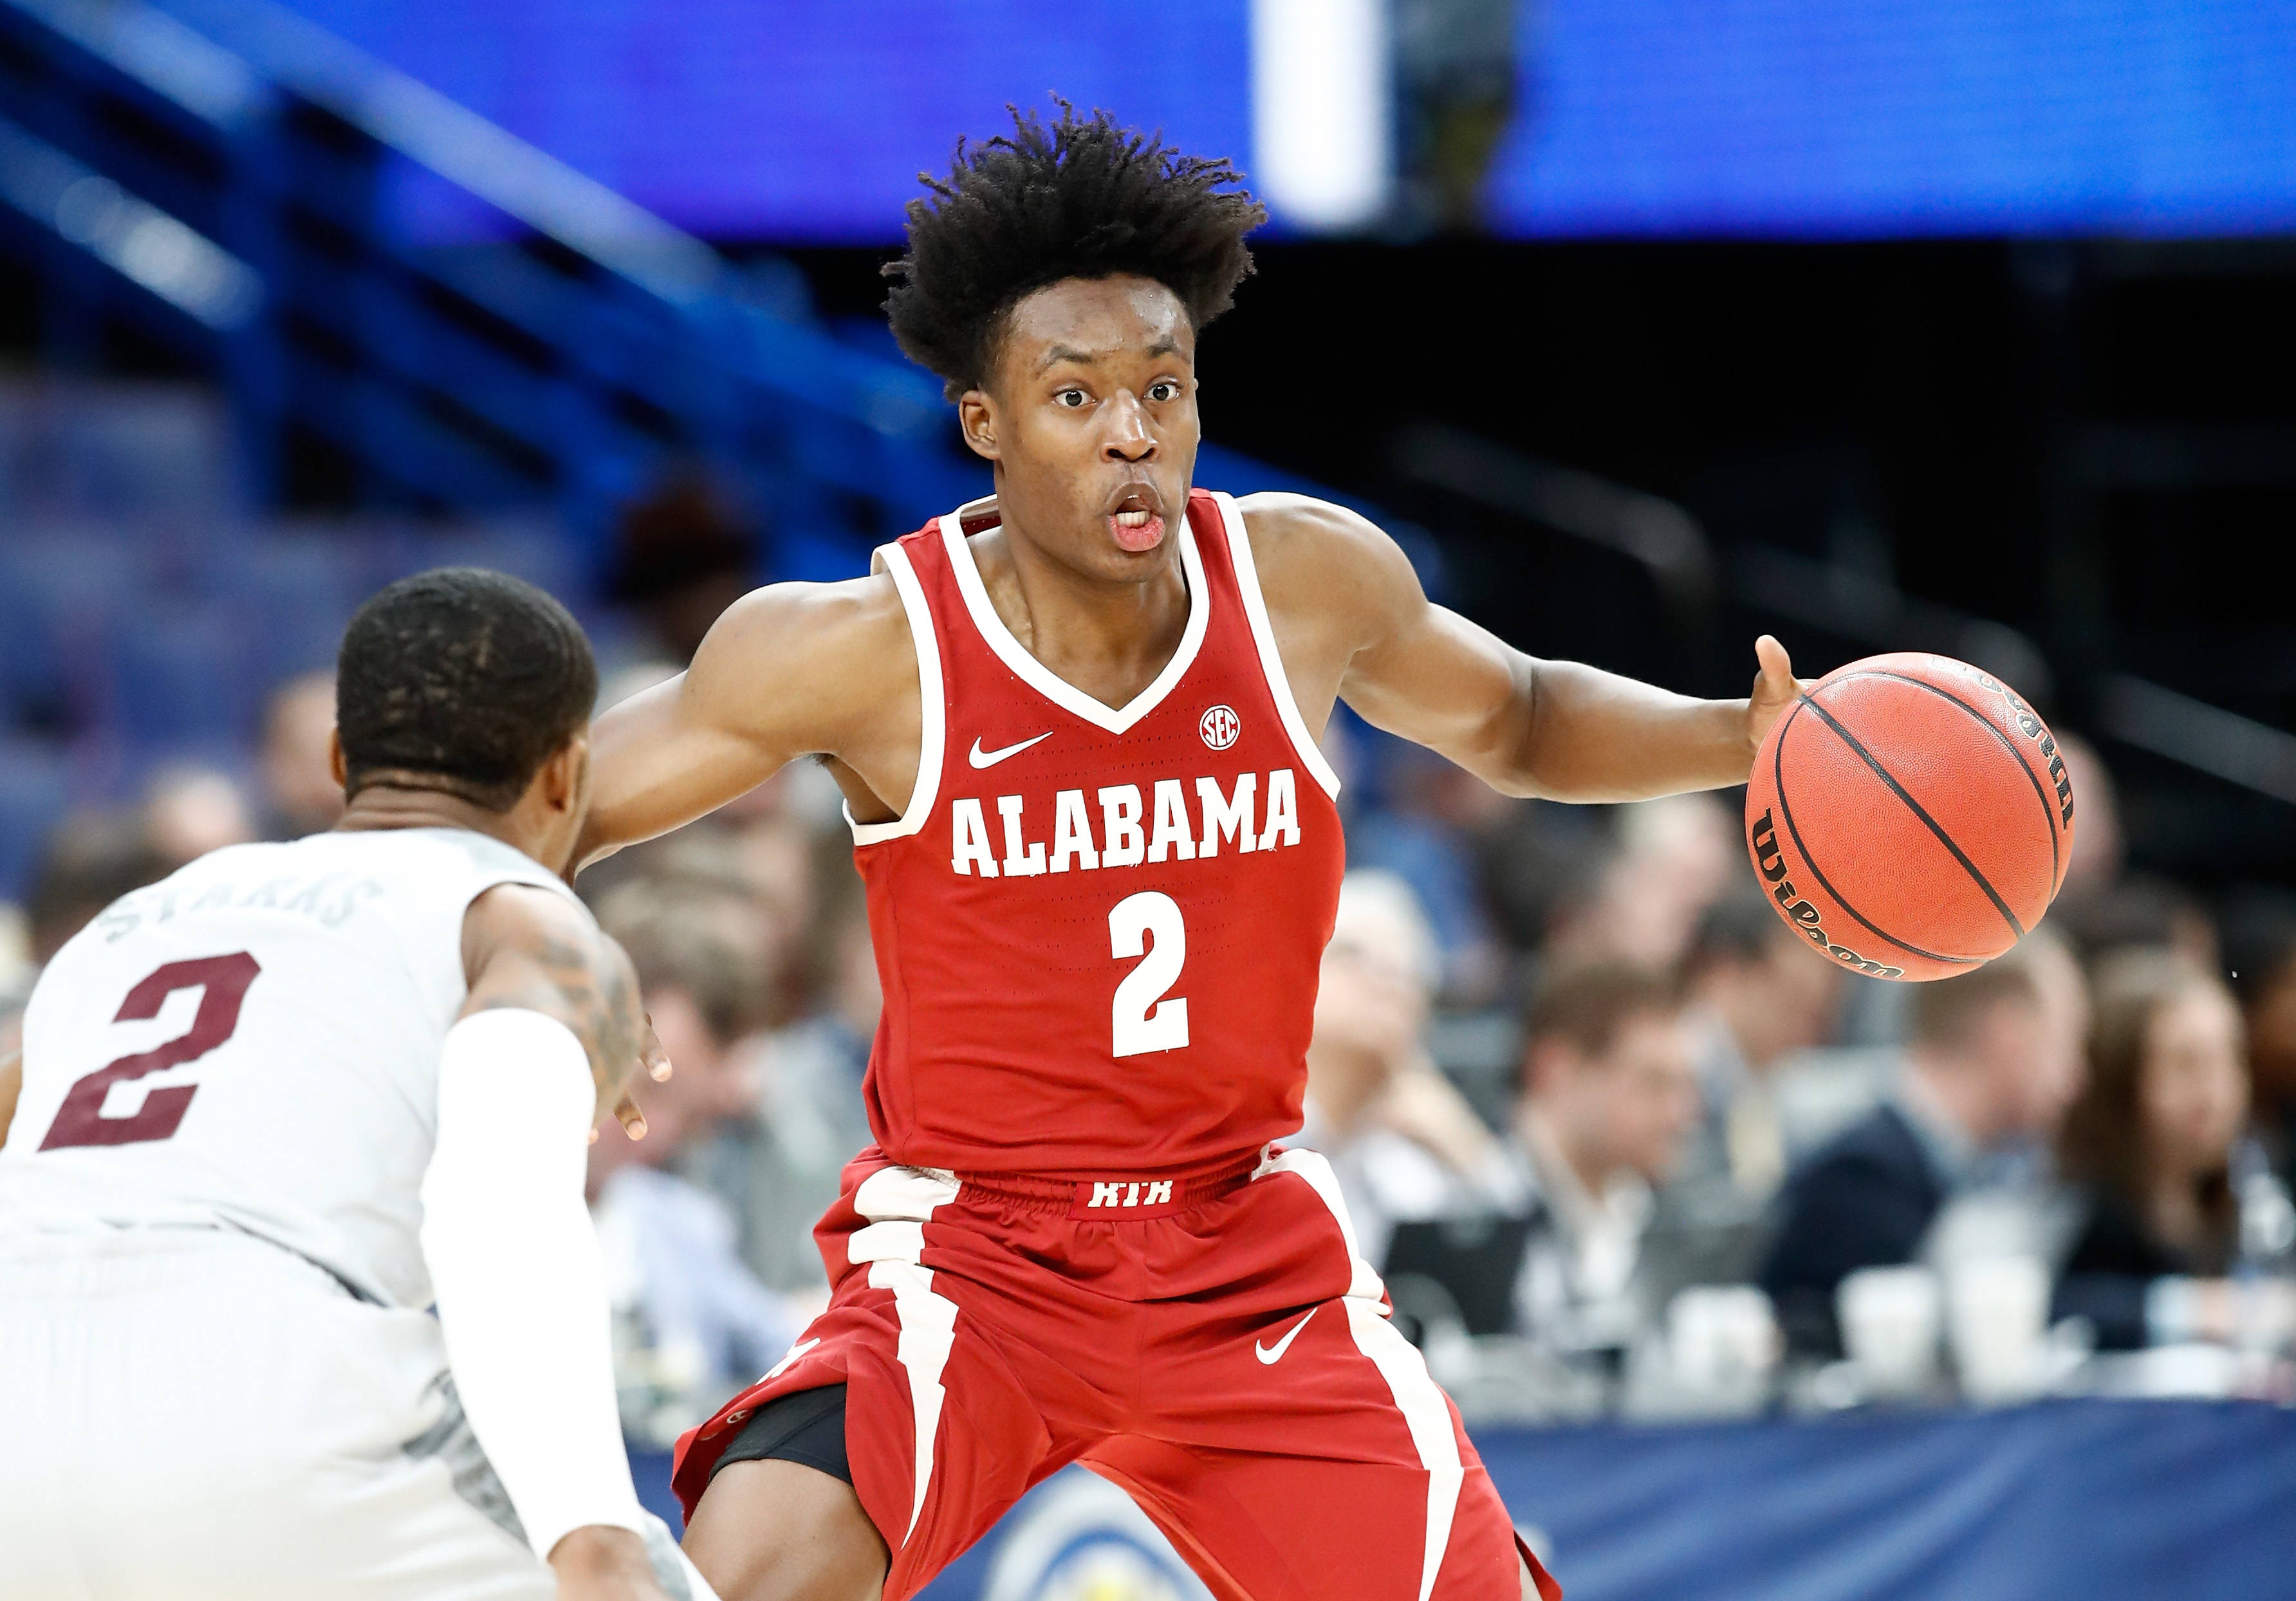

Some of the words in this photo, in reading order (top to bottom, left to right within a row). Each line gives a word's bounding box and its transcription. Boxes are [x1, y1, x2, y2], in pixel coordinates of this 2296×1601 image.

[1202, 708, 1237, 746] SEC
[951, 768, 1301, 878] ALABAMA
[1752, 807, 1905, 979] Wilson
[37, 949, 262, 1154] 2
[1107, 891, 1189, 1058] 2
